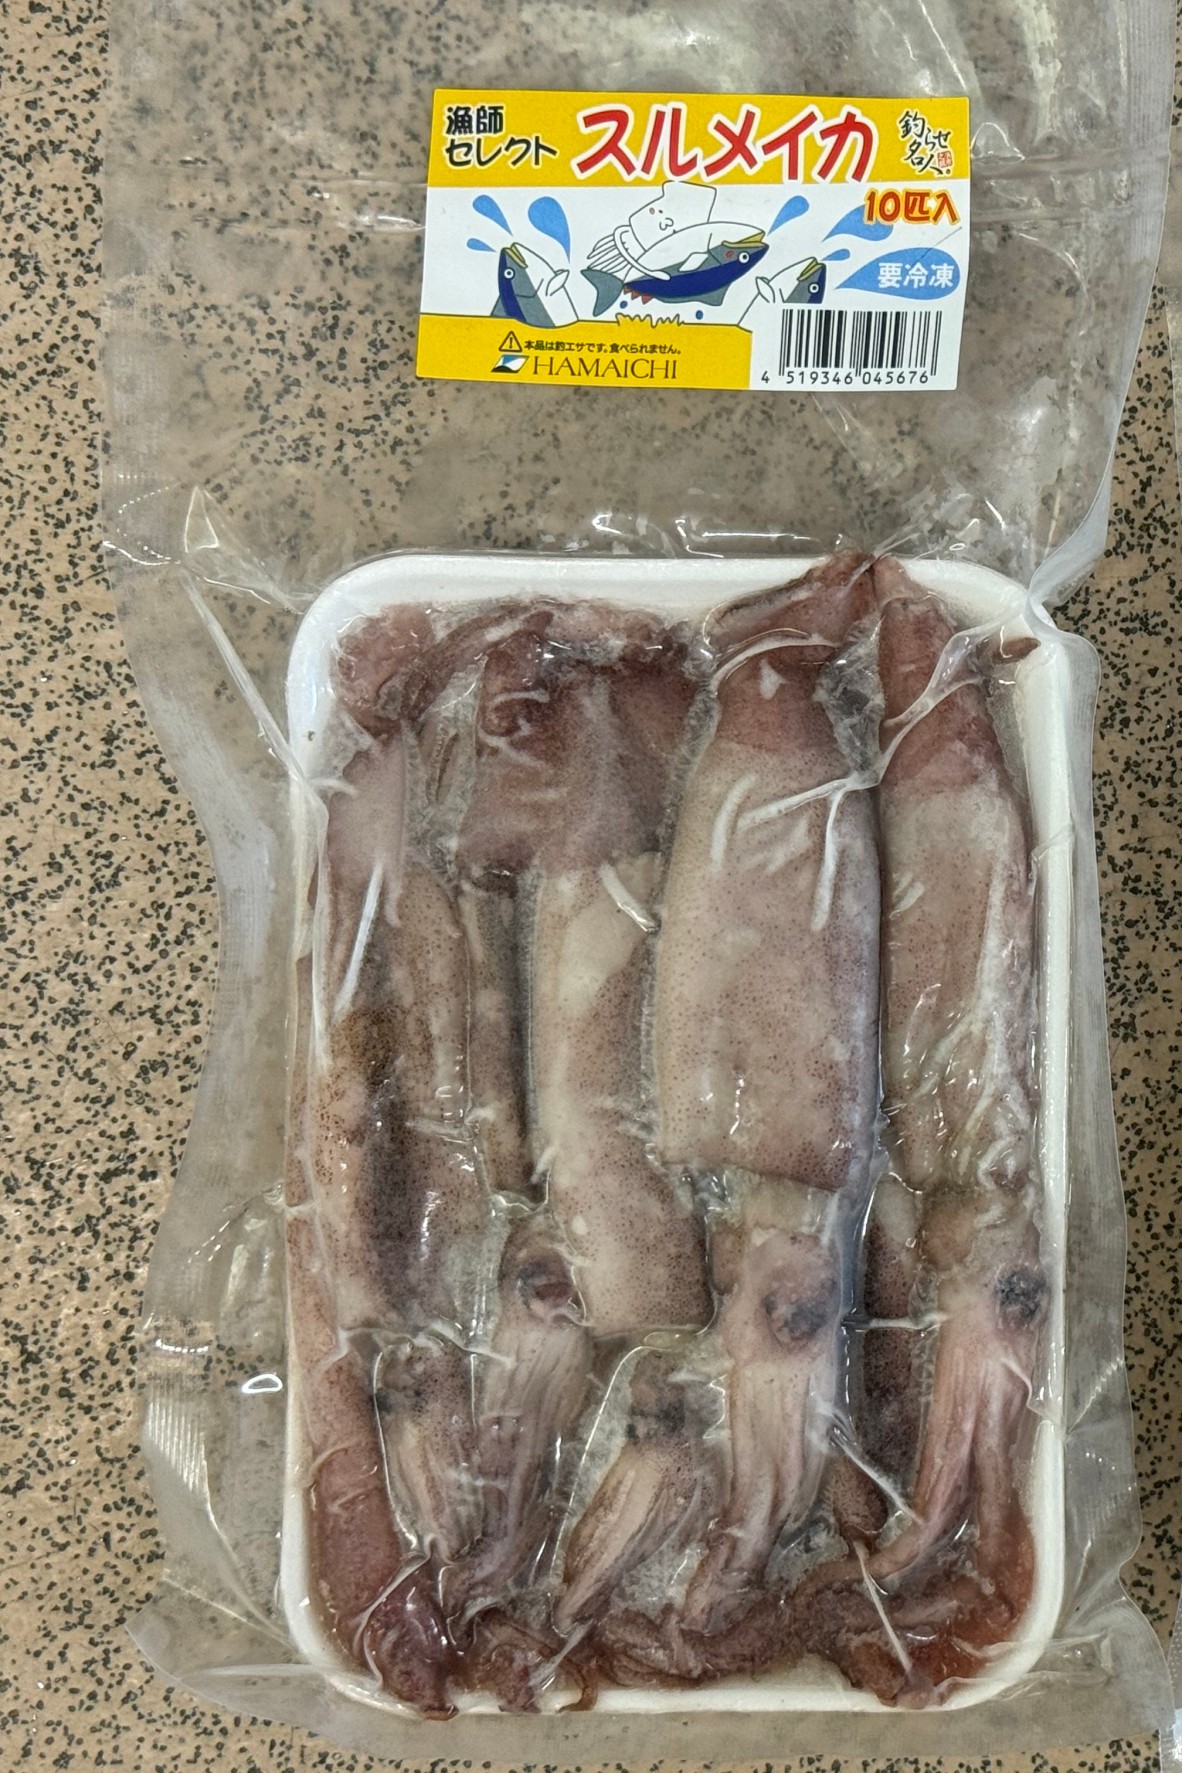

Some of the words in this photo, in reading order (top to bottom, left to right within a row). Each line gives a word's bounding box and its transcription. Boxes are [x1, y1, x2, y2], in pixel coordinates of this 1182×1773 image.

[446, 104, 504, 136] 漁師
[445, 136, 558, 168] セレクト
[575, 104, 877, 182] スルメイカ
[863, 190, 961, 224] 10匹入
[877, 261, 954, 289] 要冷凍
[533, 355, 677, 379] HAMAICHI
